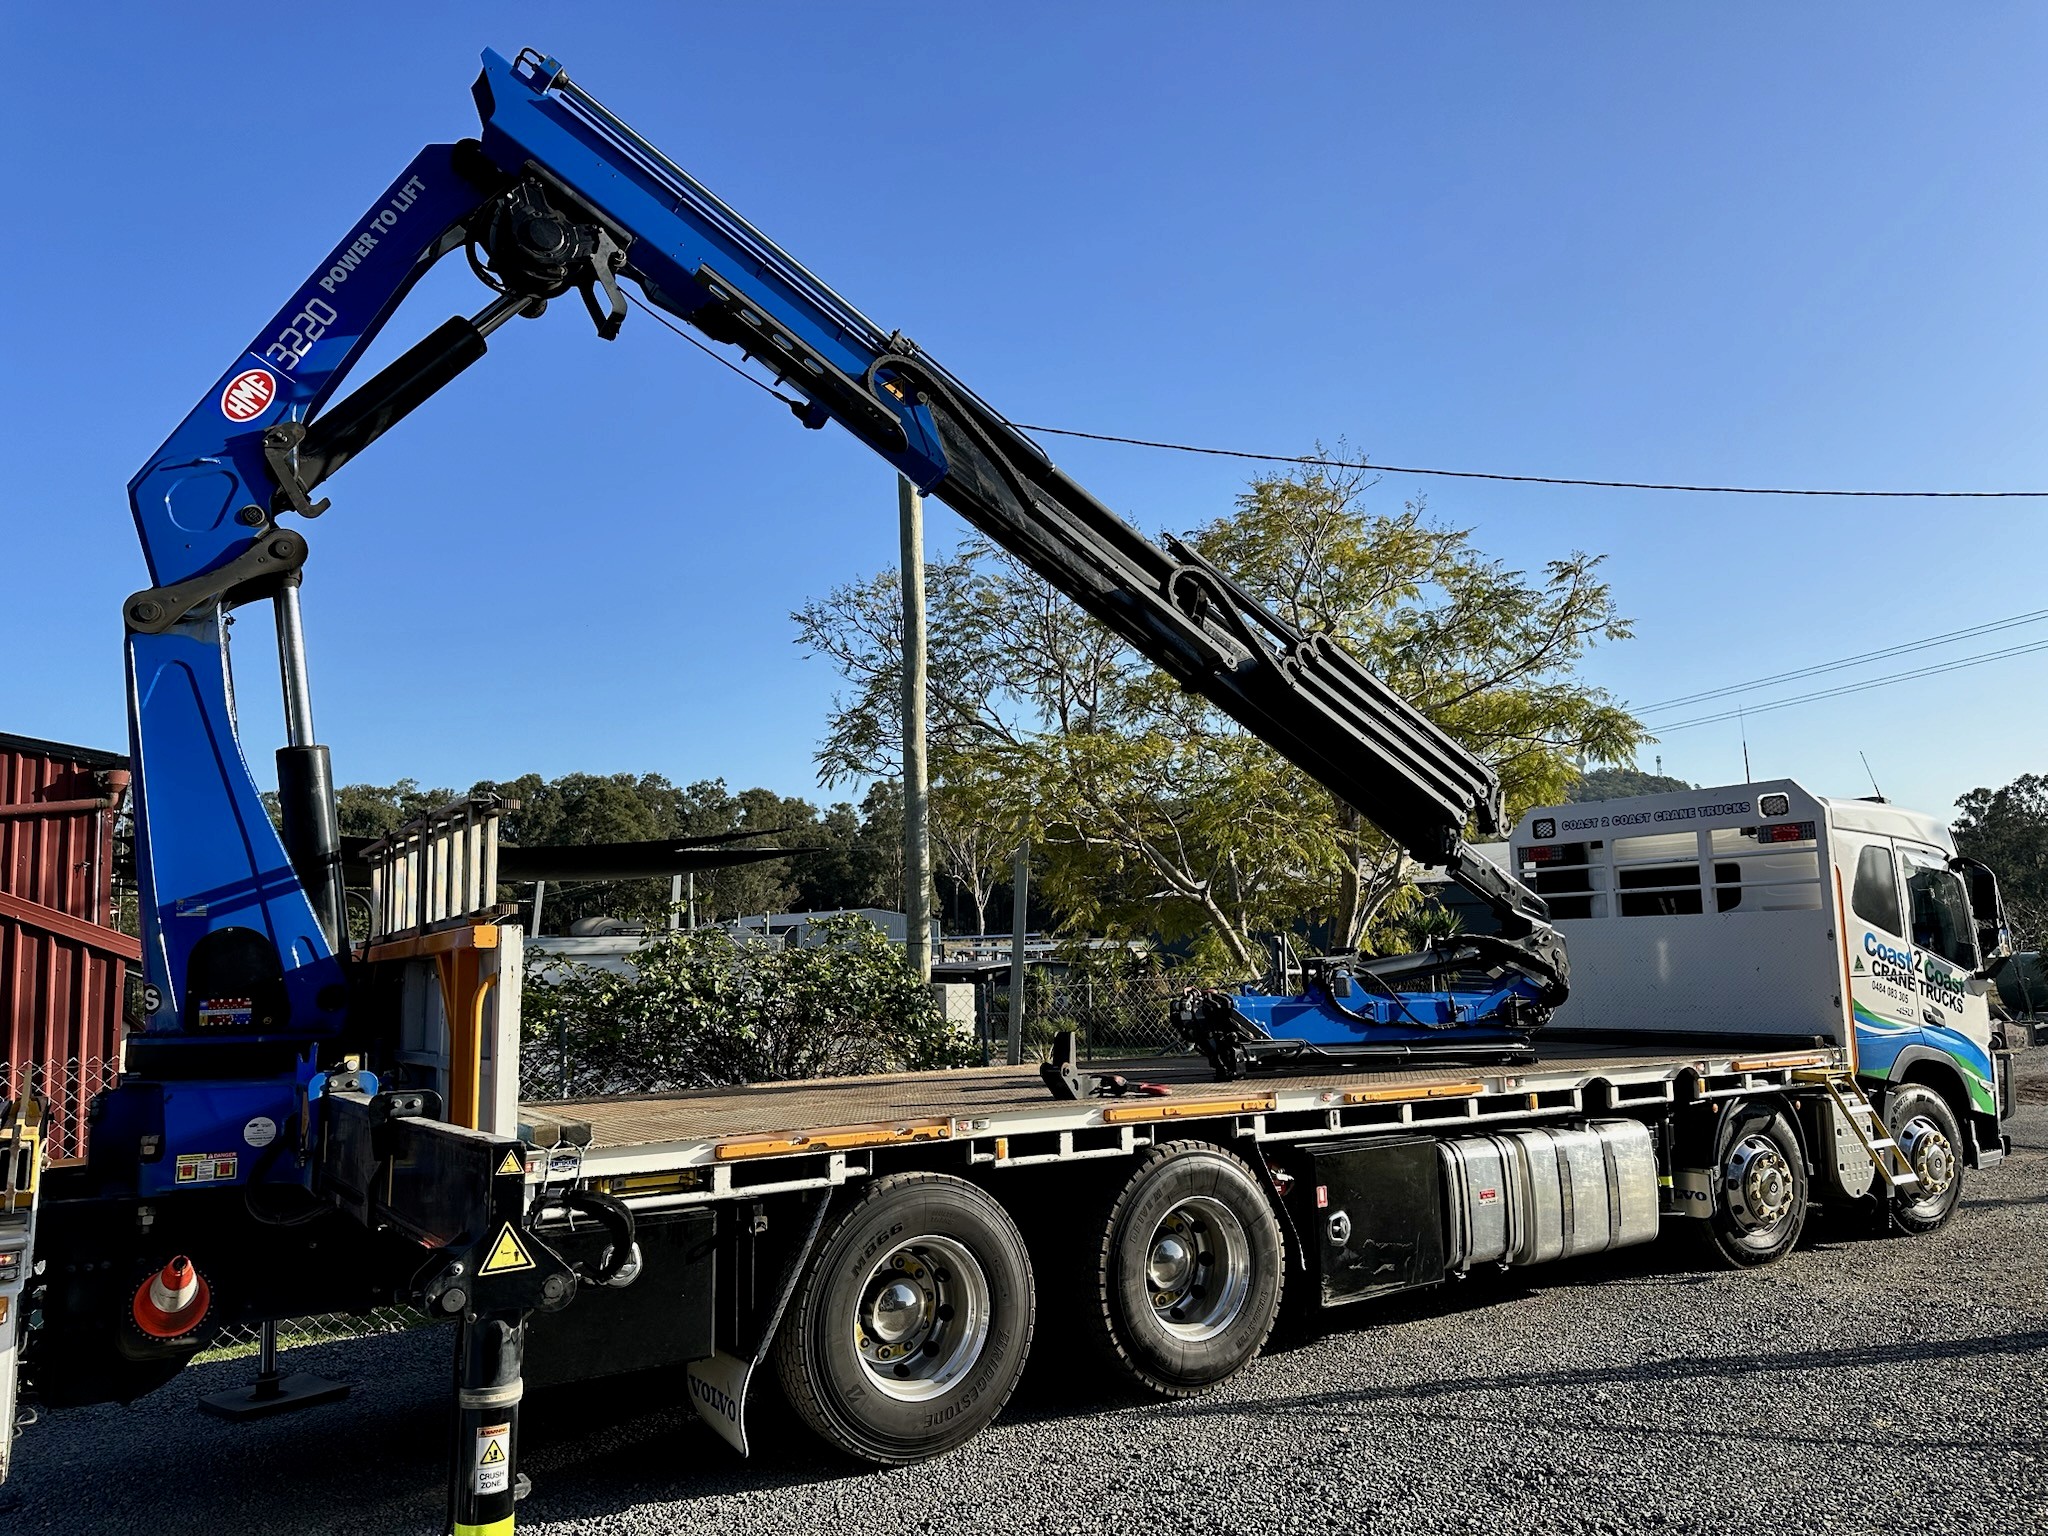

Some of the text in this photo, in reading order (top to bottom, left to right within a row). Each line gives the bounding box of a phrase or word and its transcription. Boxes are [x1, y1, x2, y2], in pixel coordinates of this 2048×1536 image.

[319, 175, 426, 293] POWER TO LIFT
[266, 298, 337, 371] 3220
[227, 374, 270, 418] HMF
[1562, 802, 1750, 831] COAST 2 COAST CRANE TRUCKS
[1863, 932, 1965, 999] Coast 2 Coast
[1872, 960, 1964, 1014] CRANE TRUCKS
[1872, 980, 1886, 994] 0484
[1899, 991, 1909, 1004] 305
[851, 1222, 904, 1279] M866
[688, 1374, 736, 1422] VOLVO
[923, 1329, 1010, 1429] BRIDGESTONE
[485, 1427, 508, 1435] WARNING
[480, 1470, 505, 1481] CRUSH
[480, 1481, 502, 1489] ZONE
